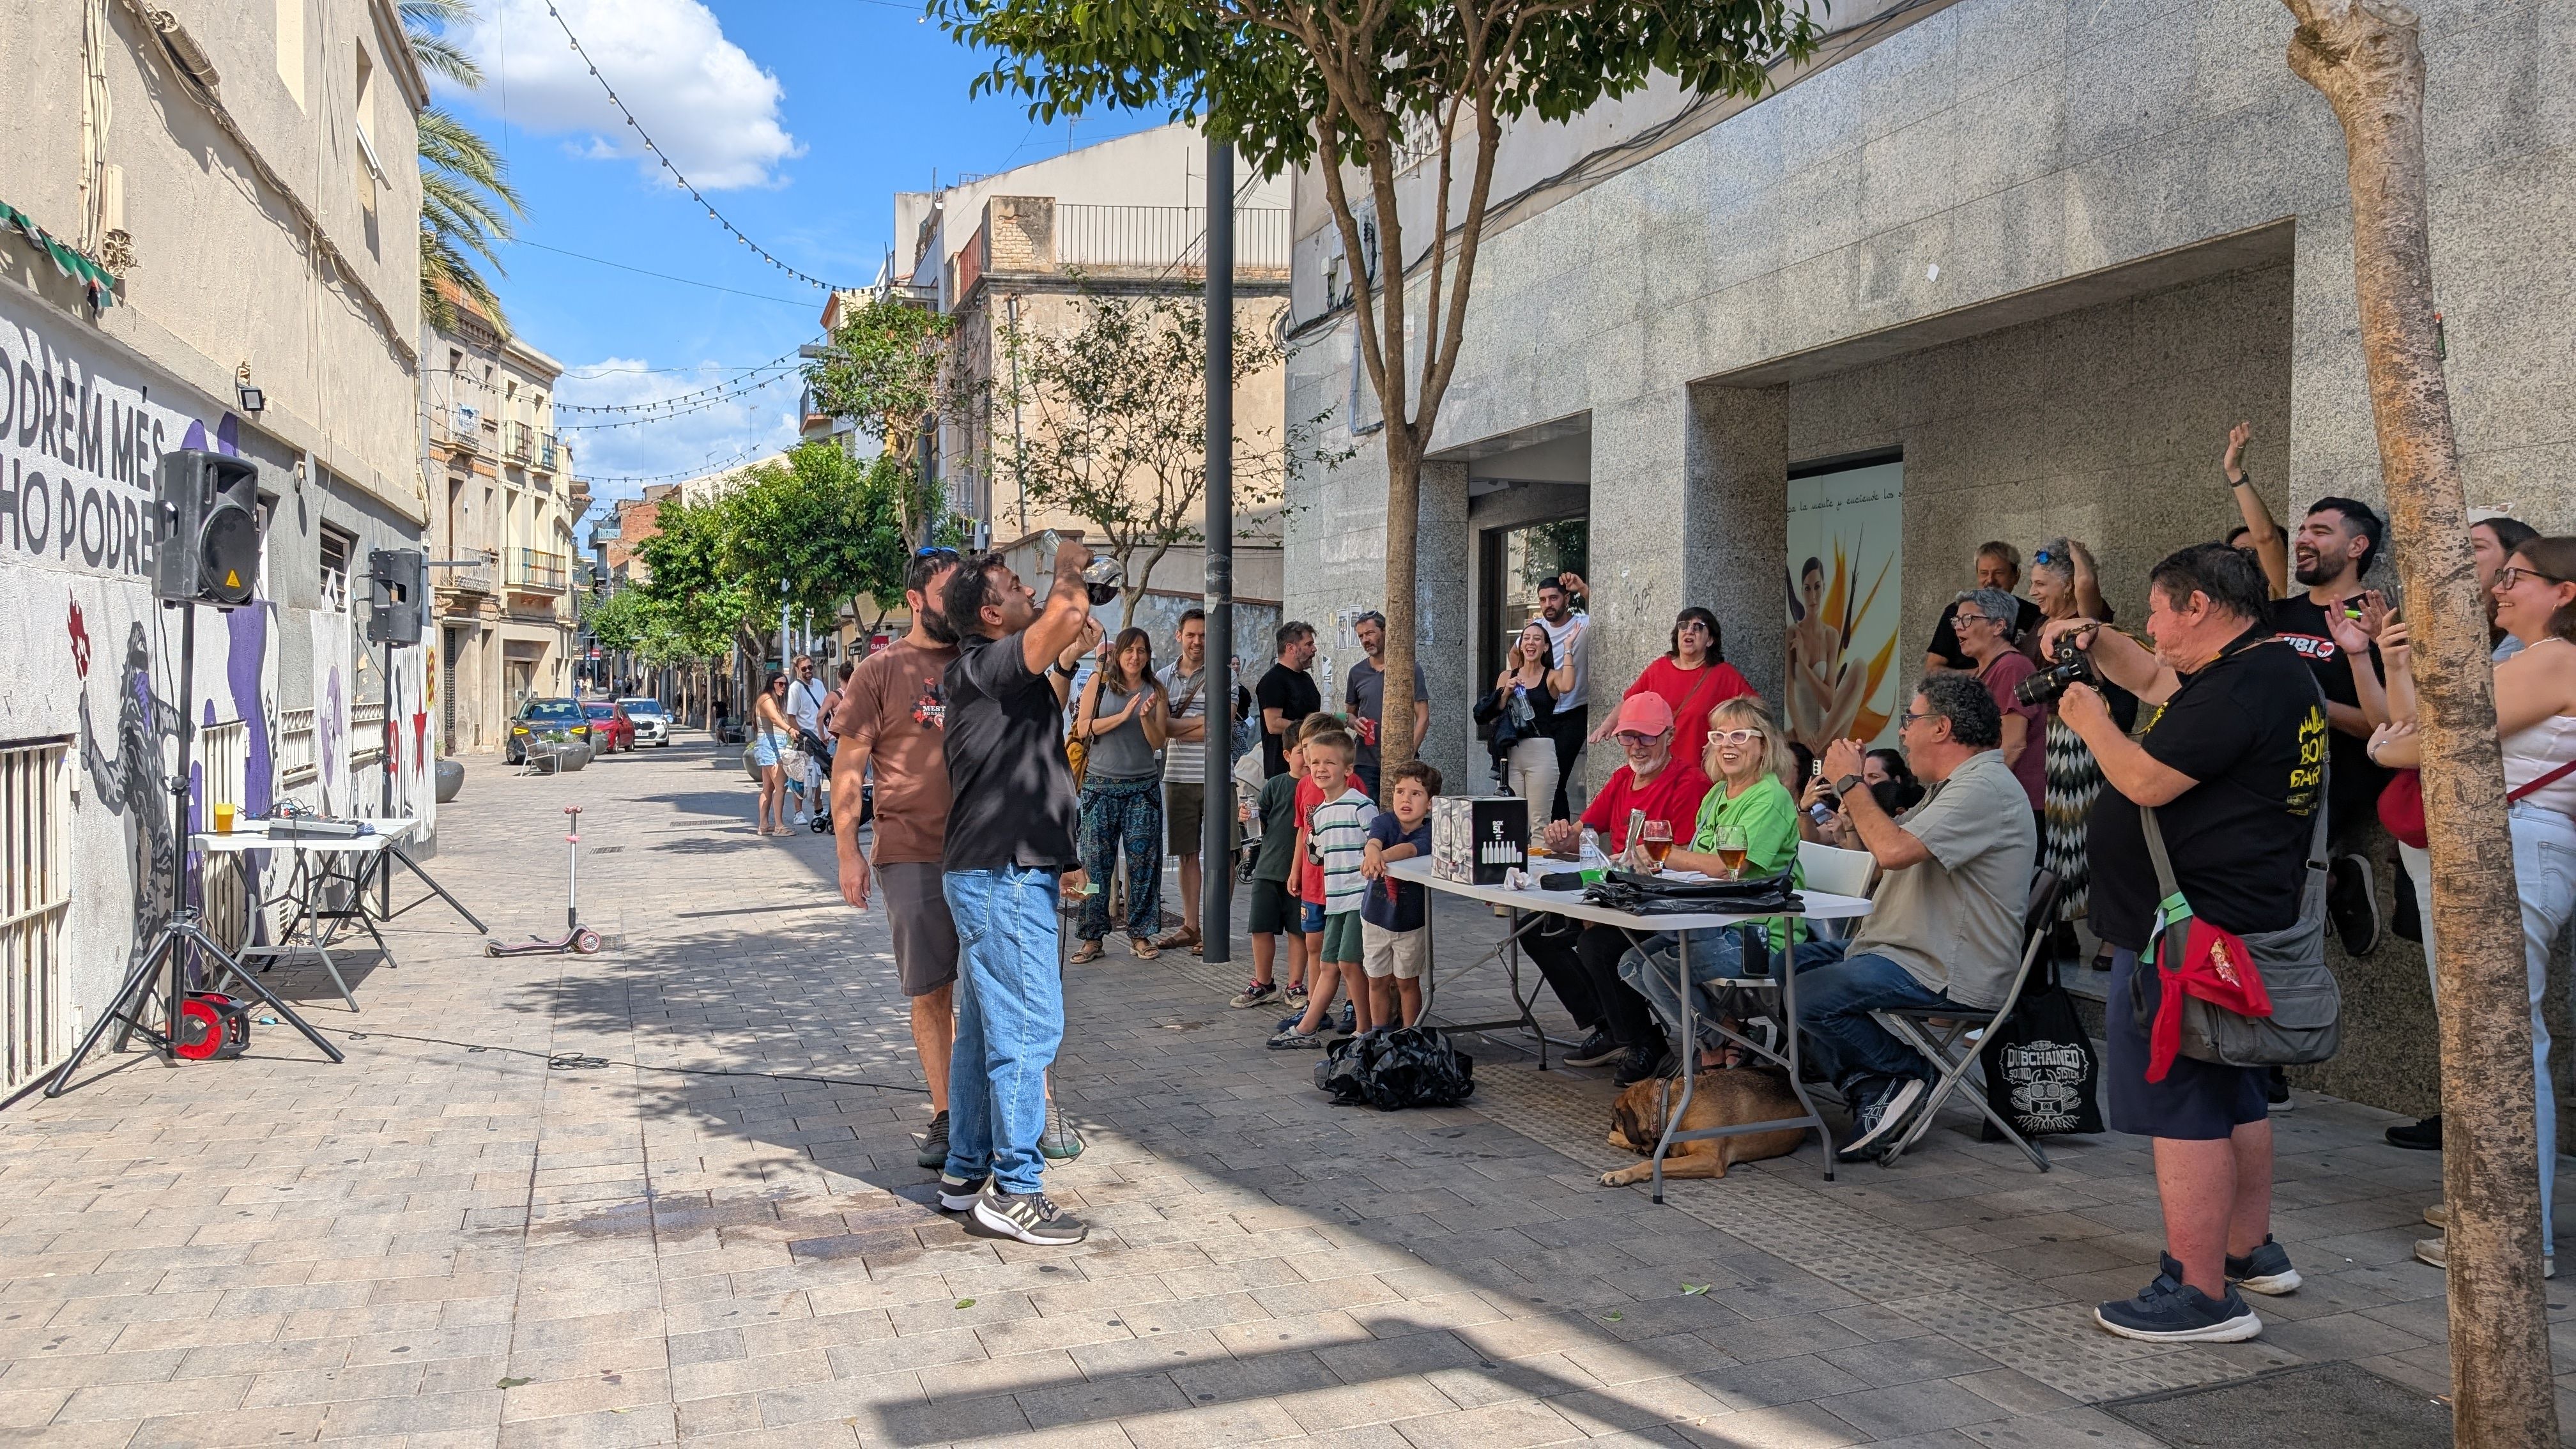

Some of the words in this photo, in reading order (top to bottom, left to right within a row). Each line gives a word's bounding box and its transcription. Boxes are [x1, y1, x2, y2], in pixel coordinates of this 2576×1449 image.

[112, 385, 165, 492] MÉS
[0, 452, 50, 555] HO
[1800, 501, 1807, 512] la
[1811, 497, 1834, 510] mente
[1846, 490, 1880, 505] enciende
[1883, 488, 1894, 500] los
[1492, 825, 1504, 834] 5L
[2007, 1048, 2080, 1069] DUBCHAINED
[2009, 1067, 2031, 1080] SOUND
[2056, 1066, 2080, 1080] SYSTEM
